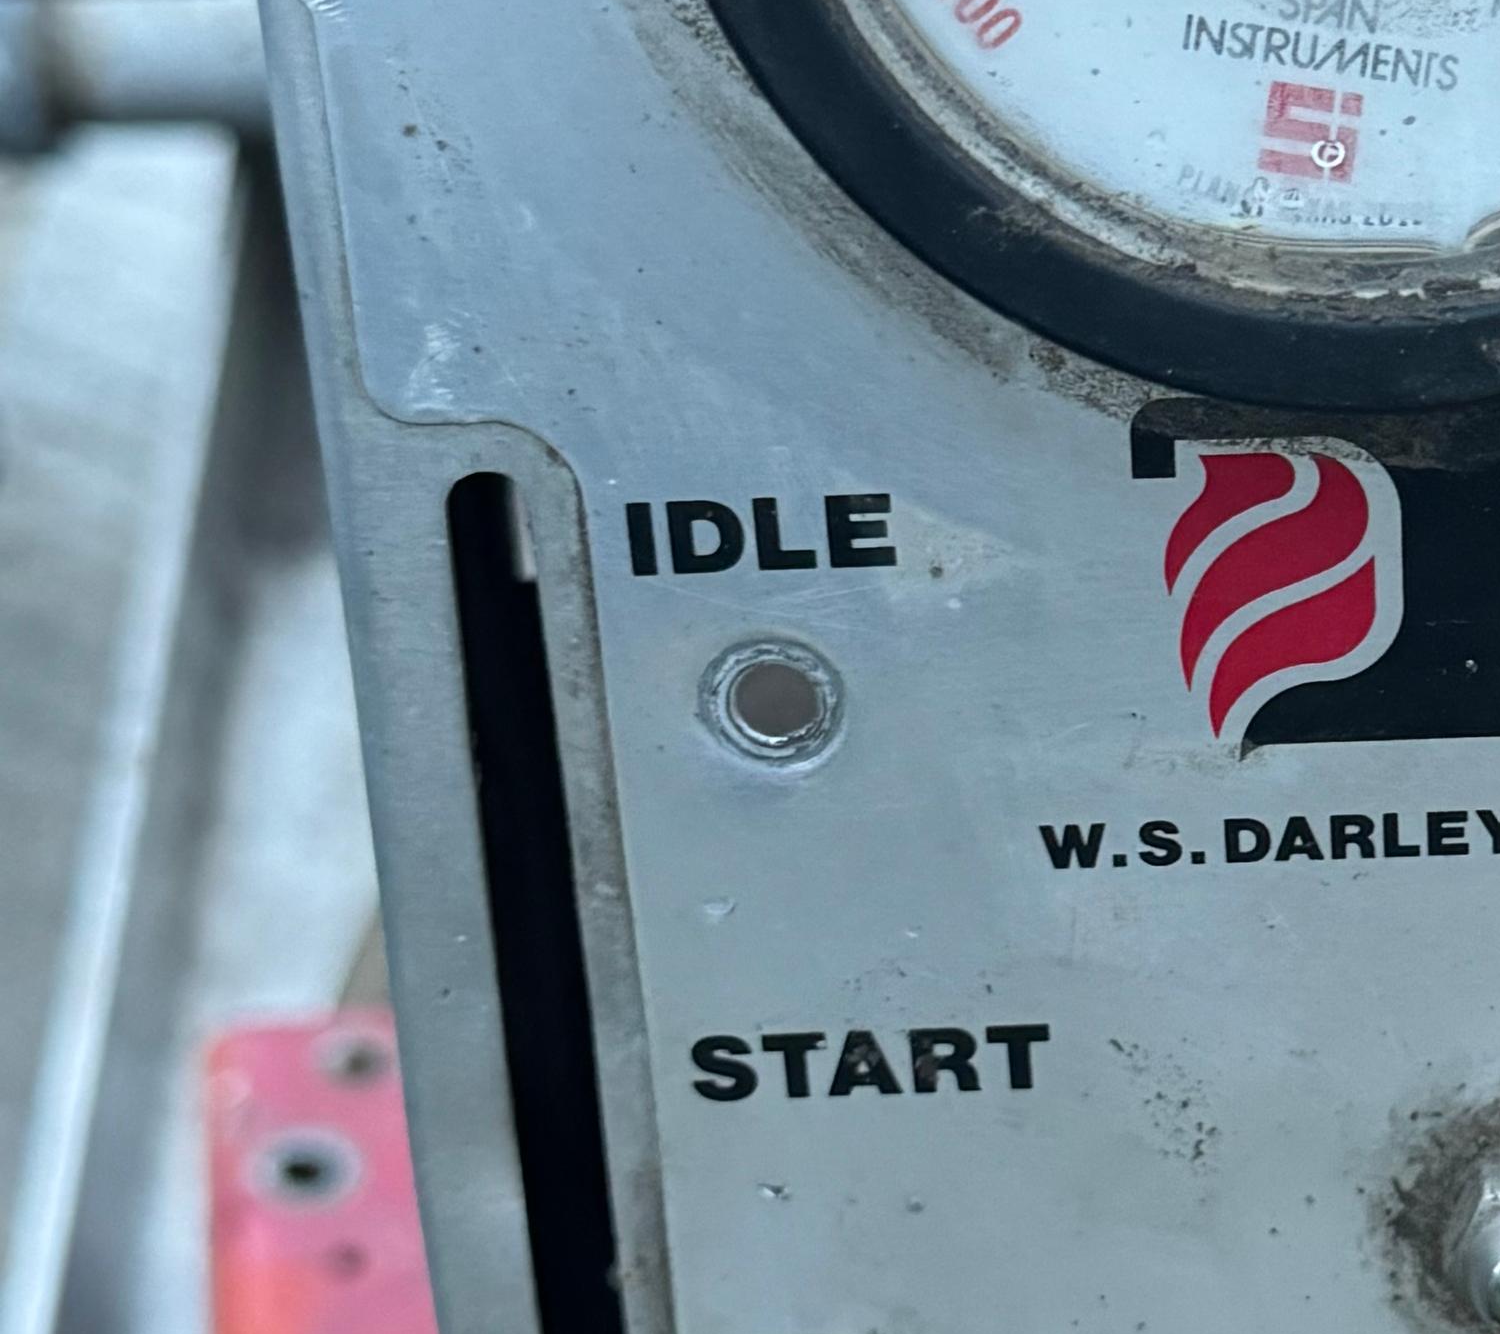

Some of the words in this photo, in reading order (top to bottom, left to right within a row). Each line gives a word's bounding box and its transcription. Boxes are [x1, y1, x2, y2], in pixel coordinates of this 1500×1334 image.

[1182, 13, 1460, 92] INSTRUMENTS
[625, 493, 897, 576] IDLE
[690, 1023, 1050, 1101] START
